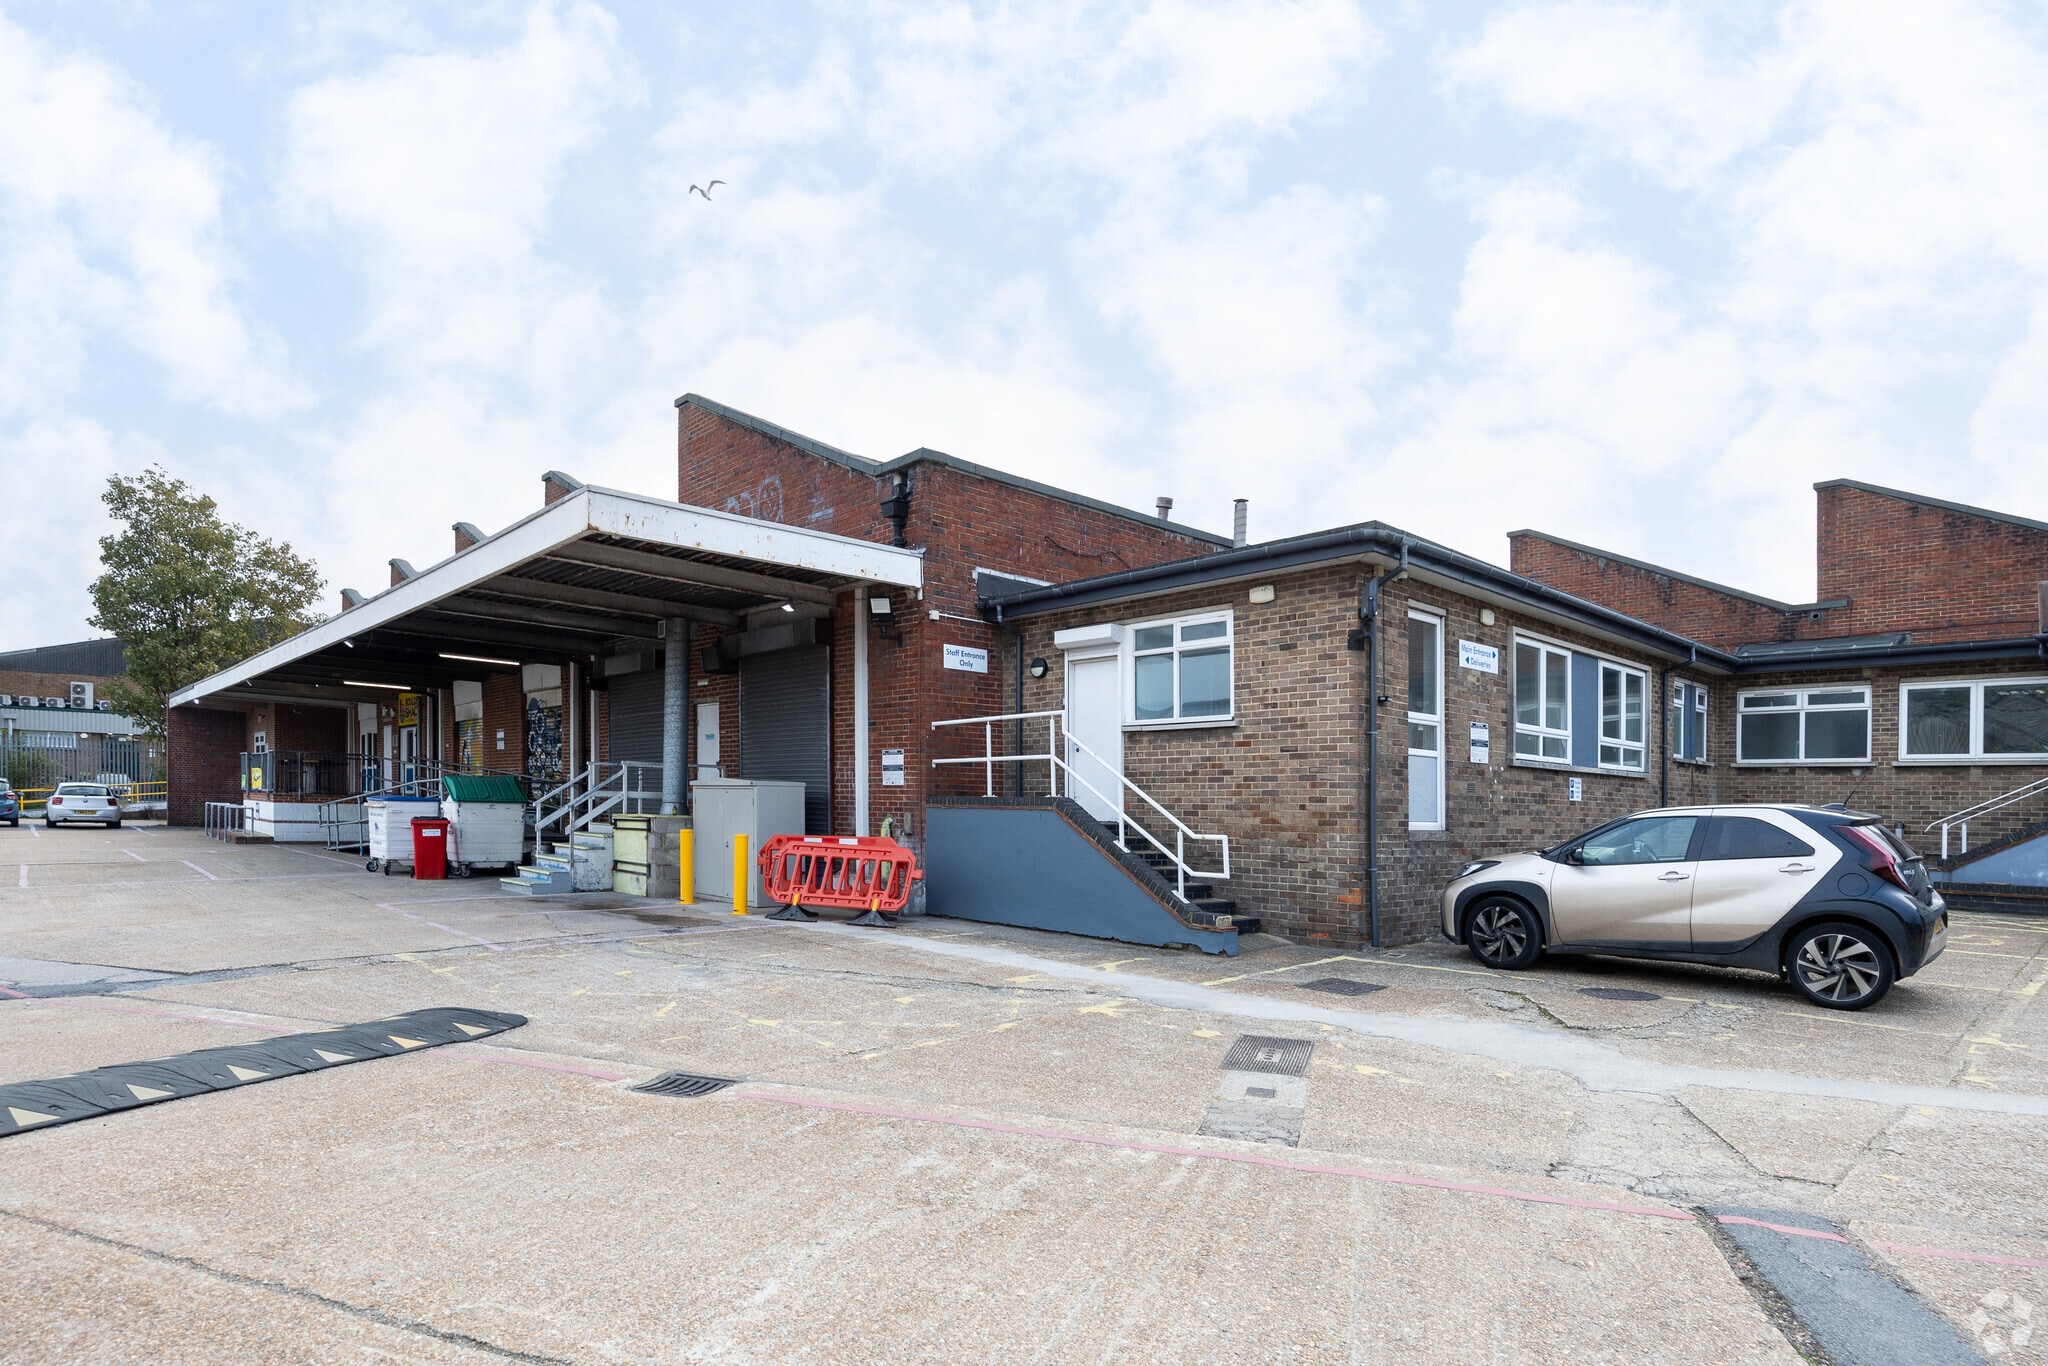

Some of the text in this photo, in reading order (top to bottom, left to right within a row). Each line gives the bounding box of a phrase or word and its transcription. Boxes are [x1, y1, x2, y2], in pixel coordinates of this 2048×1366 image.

[946, 648, 985, 660] Staff Entrance
[1461, 644, 1491, 658] Main Entrance
[960, 660, 973, 669] Only
[1471, 657, 1491, 669] Deliveries
